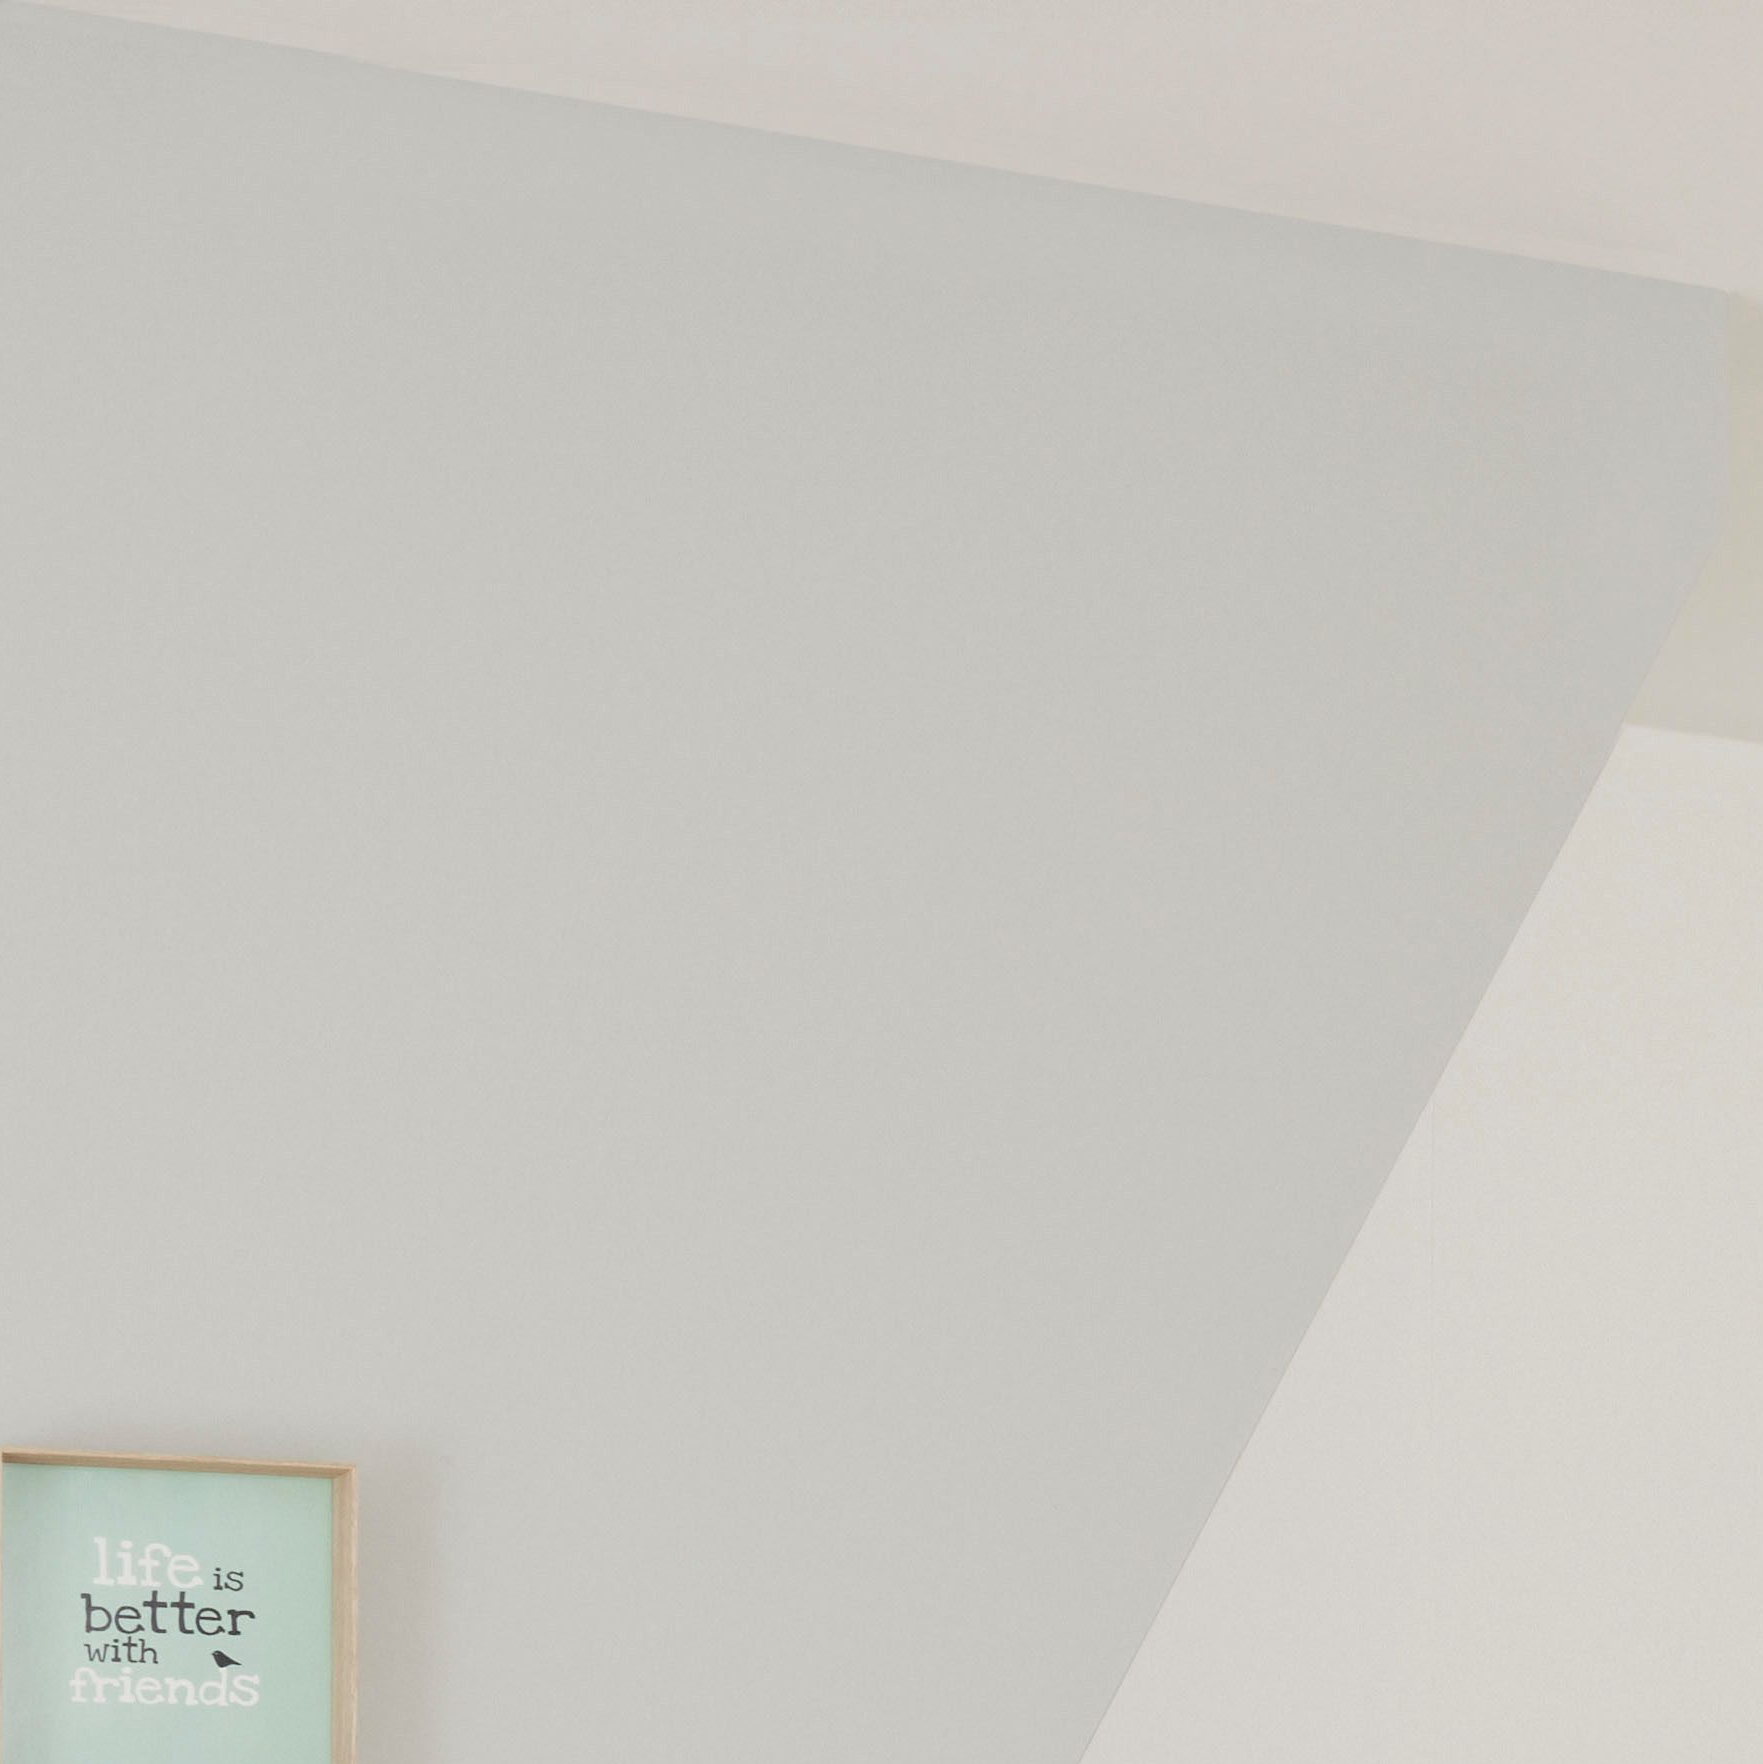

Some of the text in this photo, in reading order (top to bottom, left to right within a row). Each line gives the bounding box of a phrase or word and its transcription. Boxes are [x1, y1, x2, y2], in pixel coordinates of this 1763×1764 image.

[93, 1536, 244, 1591] life is
[80, 1590, 256, 1636] better
[84, 1636, 159, 1664] with
[68, 1666, 260, 1707] friends
